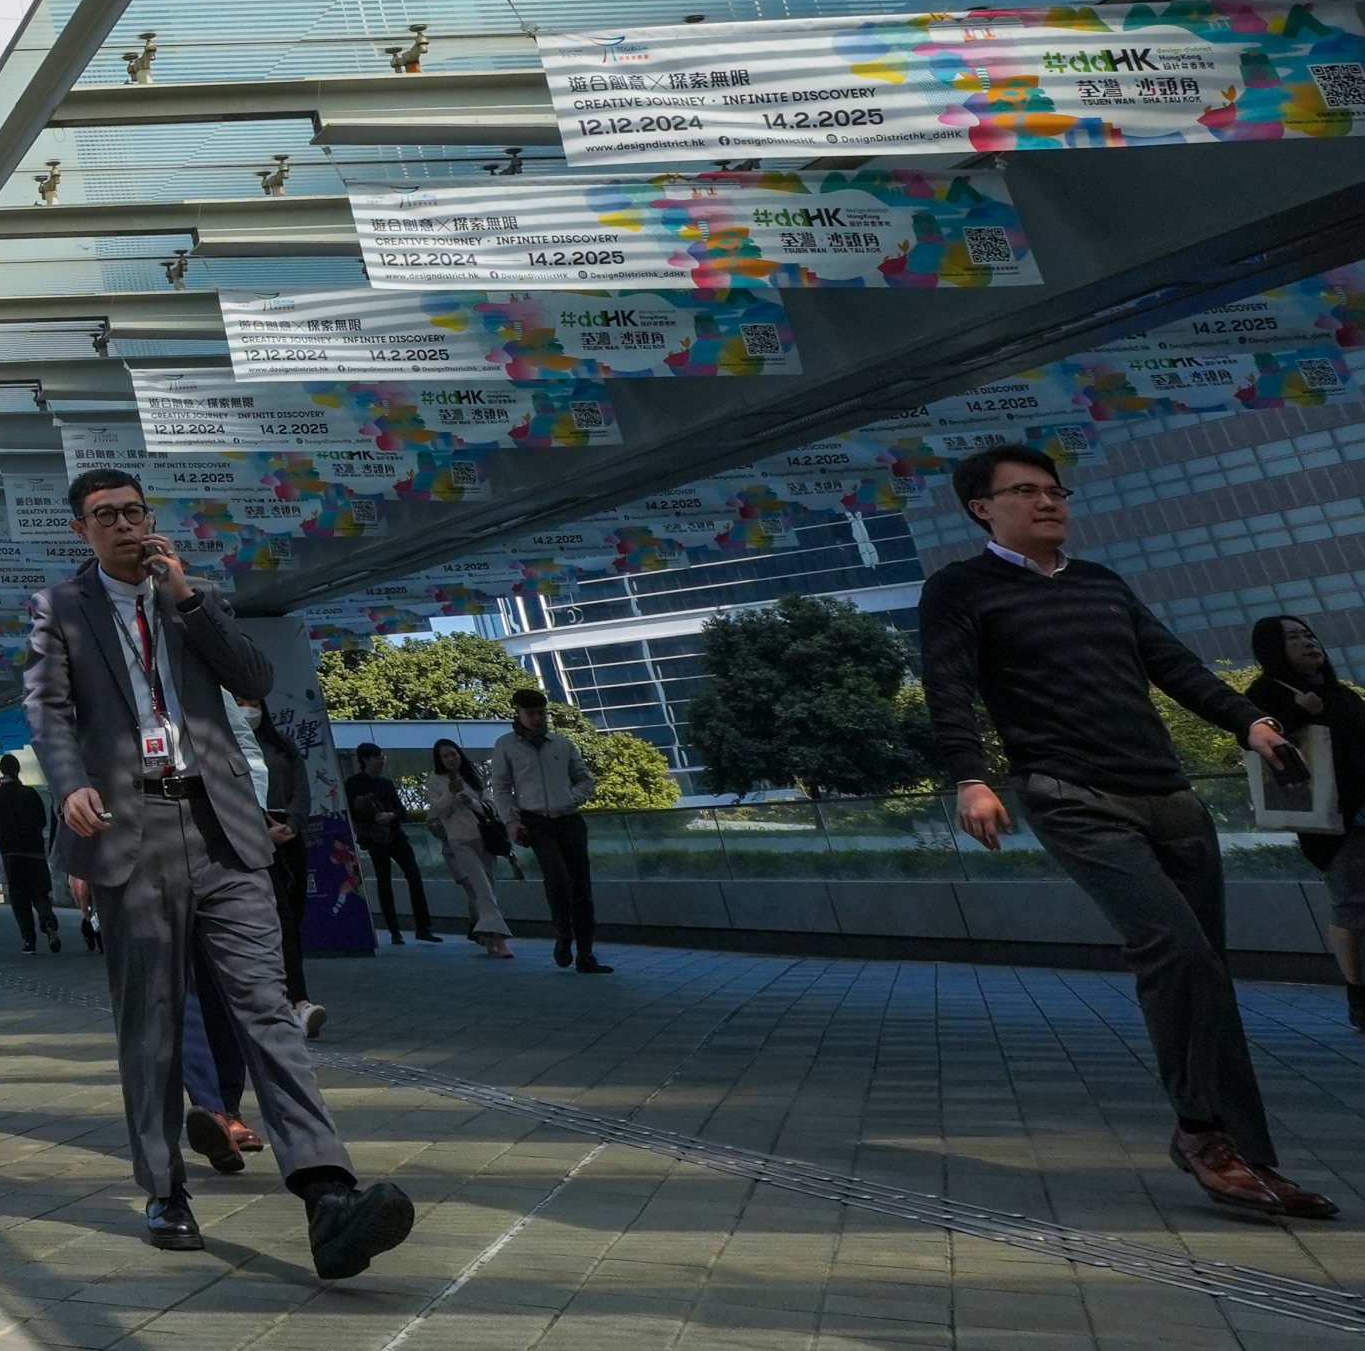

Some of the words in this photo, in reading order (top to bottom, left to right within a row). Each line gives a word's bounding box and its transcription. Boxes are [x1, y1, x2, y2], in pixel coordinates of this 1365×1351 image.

[574, 97, 642, 110] CREATIVE
[646, 96, 705, 107] JOURNEY
[723, 93, 789, 105] INFINITE
[792, 87, 876, 102] DISCOVERY
[579, 115, 704, 136] 12.12.2024
[763, 108, 884, 129] 14.2.2025
[586, 139, 705, 152] www.designdistrict.hk
[733, 137, 816, 147] DesignDistrictHK
[376, 237, 429, 246] CREATIVE
[433, 237, 482, 246] JOURNEY
[496, 236, 549, 245] INFINITE
[552, 234, 618, 244] DISCOVERY
[379, 253, 477, 266] 12.12.2024
[528, 251, 624, 266] 14.2.2025
[1193, 317, 1278, 335] 14.2.2025
[343, 336, 387, 344] INFINITE
[389, 335, 446, 343] DISCOVERY
[245, 350, 328, 361] 12.12.2024
[370, 349, 449, 361] 14.2.2025
[966, 397, 1038, 413] 14.2.2025
[154, 424, 225, 434] 12.12.2024
[261, 424, 328, 434] 14.2.2025
[787, 454, 849, 467] 14.2.2025
[173, 473, 234, 483] 14.2.2025
[646, 498, 702, 511] 14.2.2025
[533, 535, 583, 545] 14.2.2025
[46, 549, 95, 557] 14.2.2025
